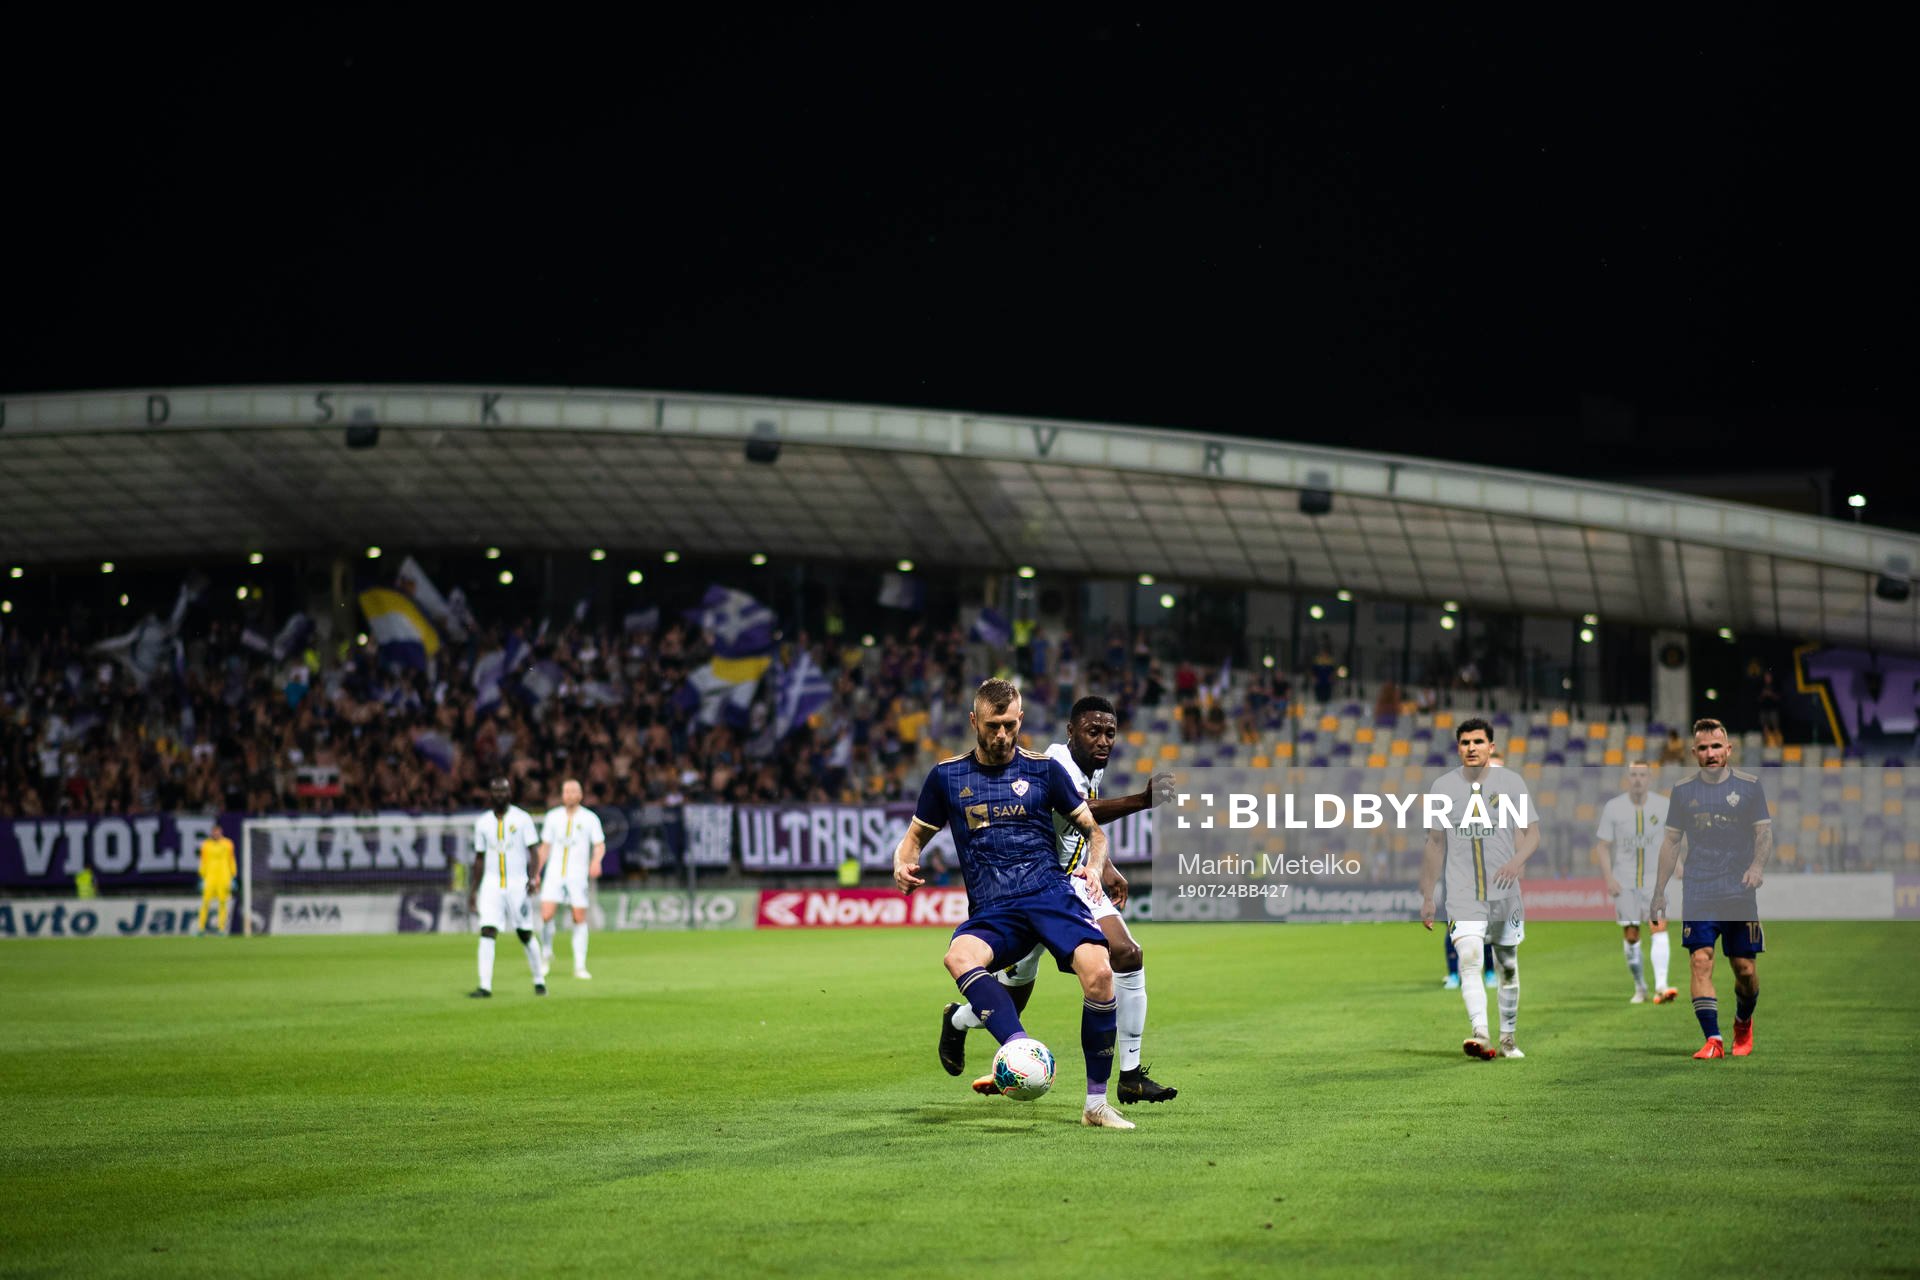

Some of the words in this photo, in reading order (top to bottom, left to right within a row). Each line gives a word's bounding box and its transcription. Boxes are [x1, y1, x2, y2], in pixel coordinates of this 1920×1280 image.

[993, 804, 1027, 817] SAVA
[738, 807, 888, 866] ULTRAS
[281, 904, 342, 922] SAVA
[804, 892, 907, 925] Nova
